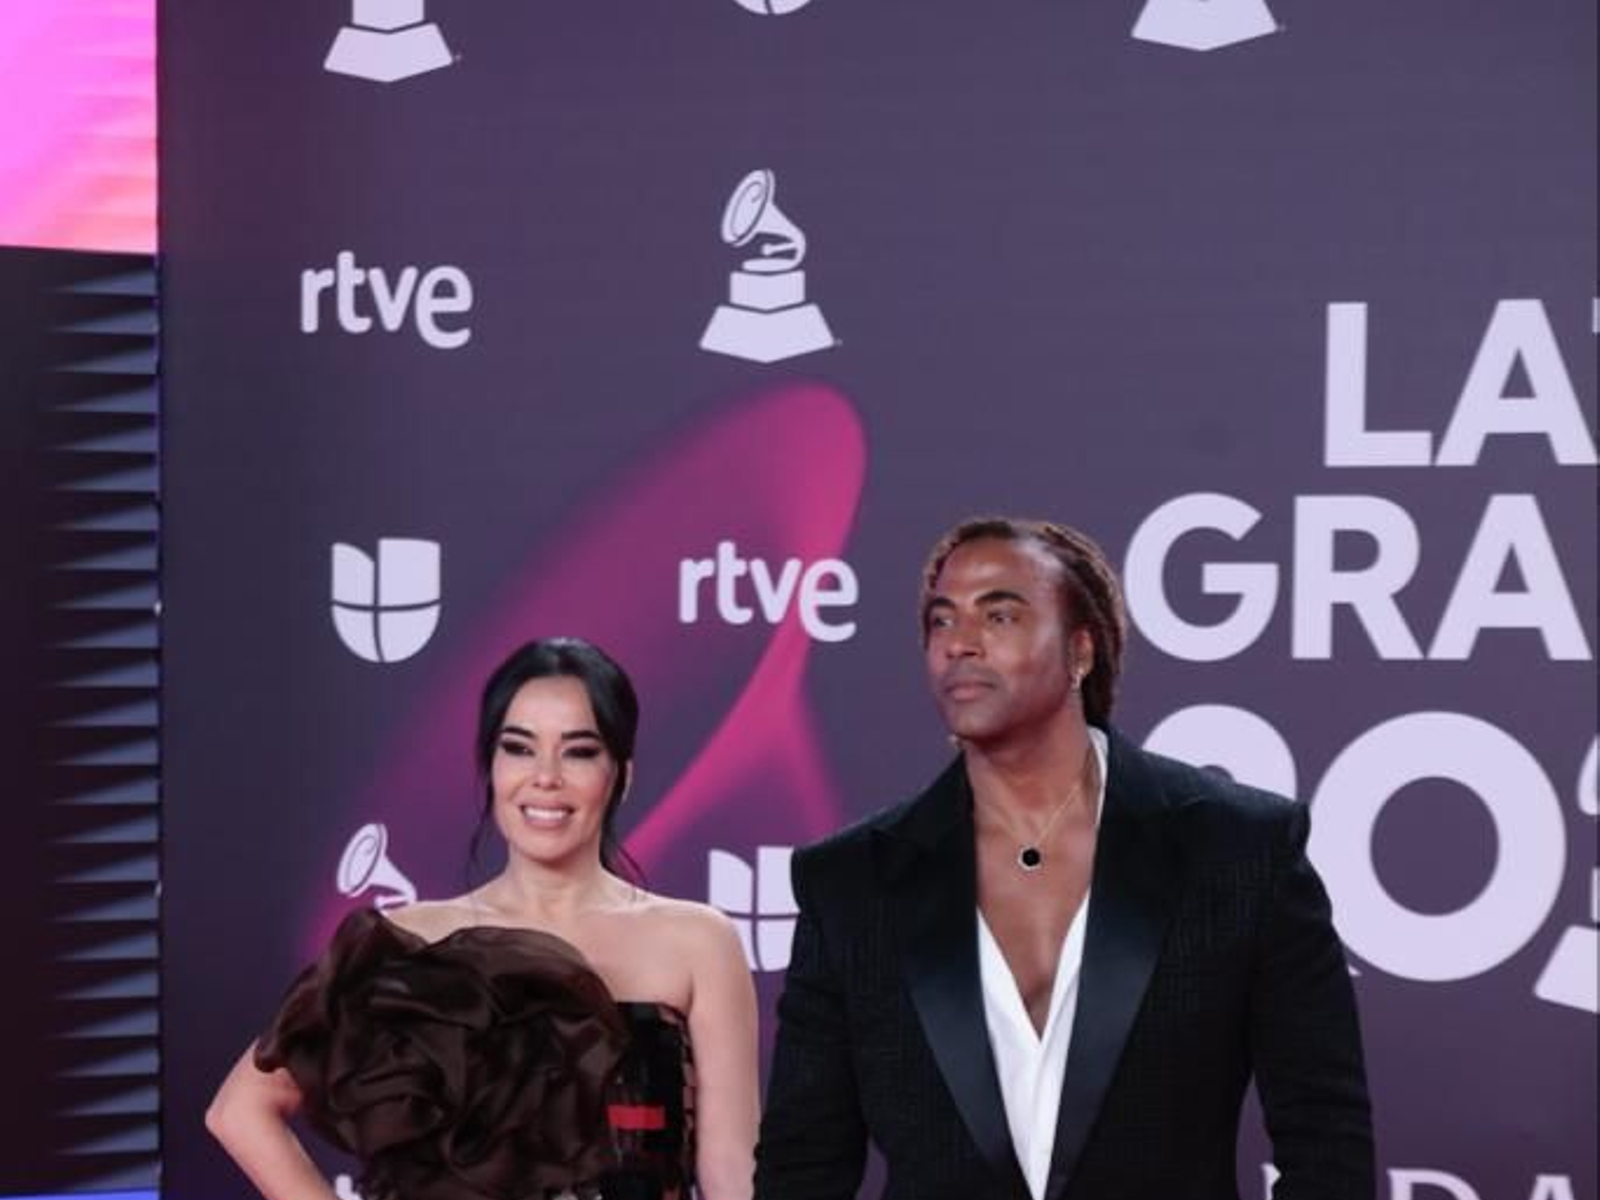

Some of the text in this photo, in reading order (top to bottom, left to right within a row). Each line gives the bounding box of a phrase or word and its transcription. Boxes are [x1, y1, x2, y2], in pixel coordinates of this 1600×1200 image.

[300, 251, 474, 349] rtve
[1324, 298, 1600, 468] LA
[679, 541, 858, 642] rtve
[1123, 491, 1592, 661] GRA
